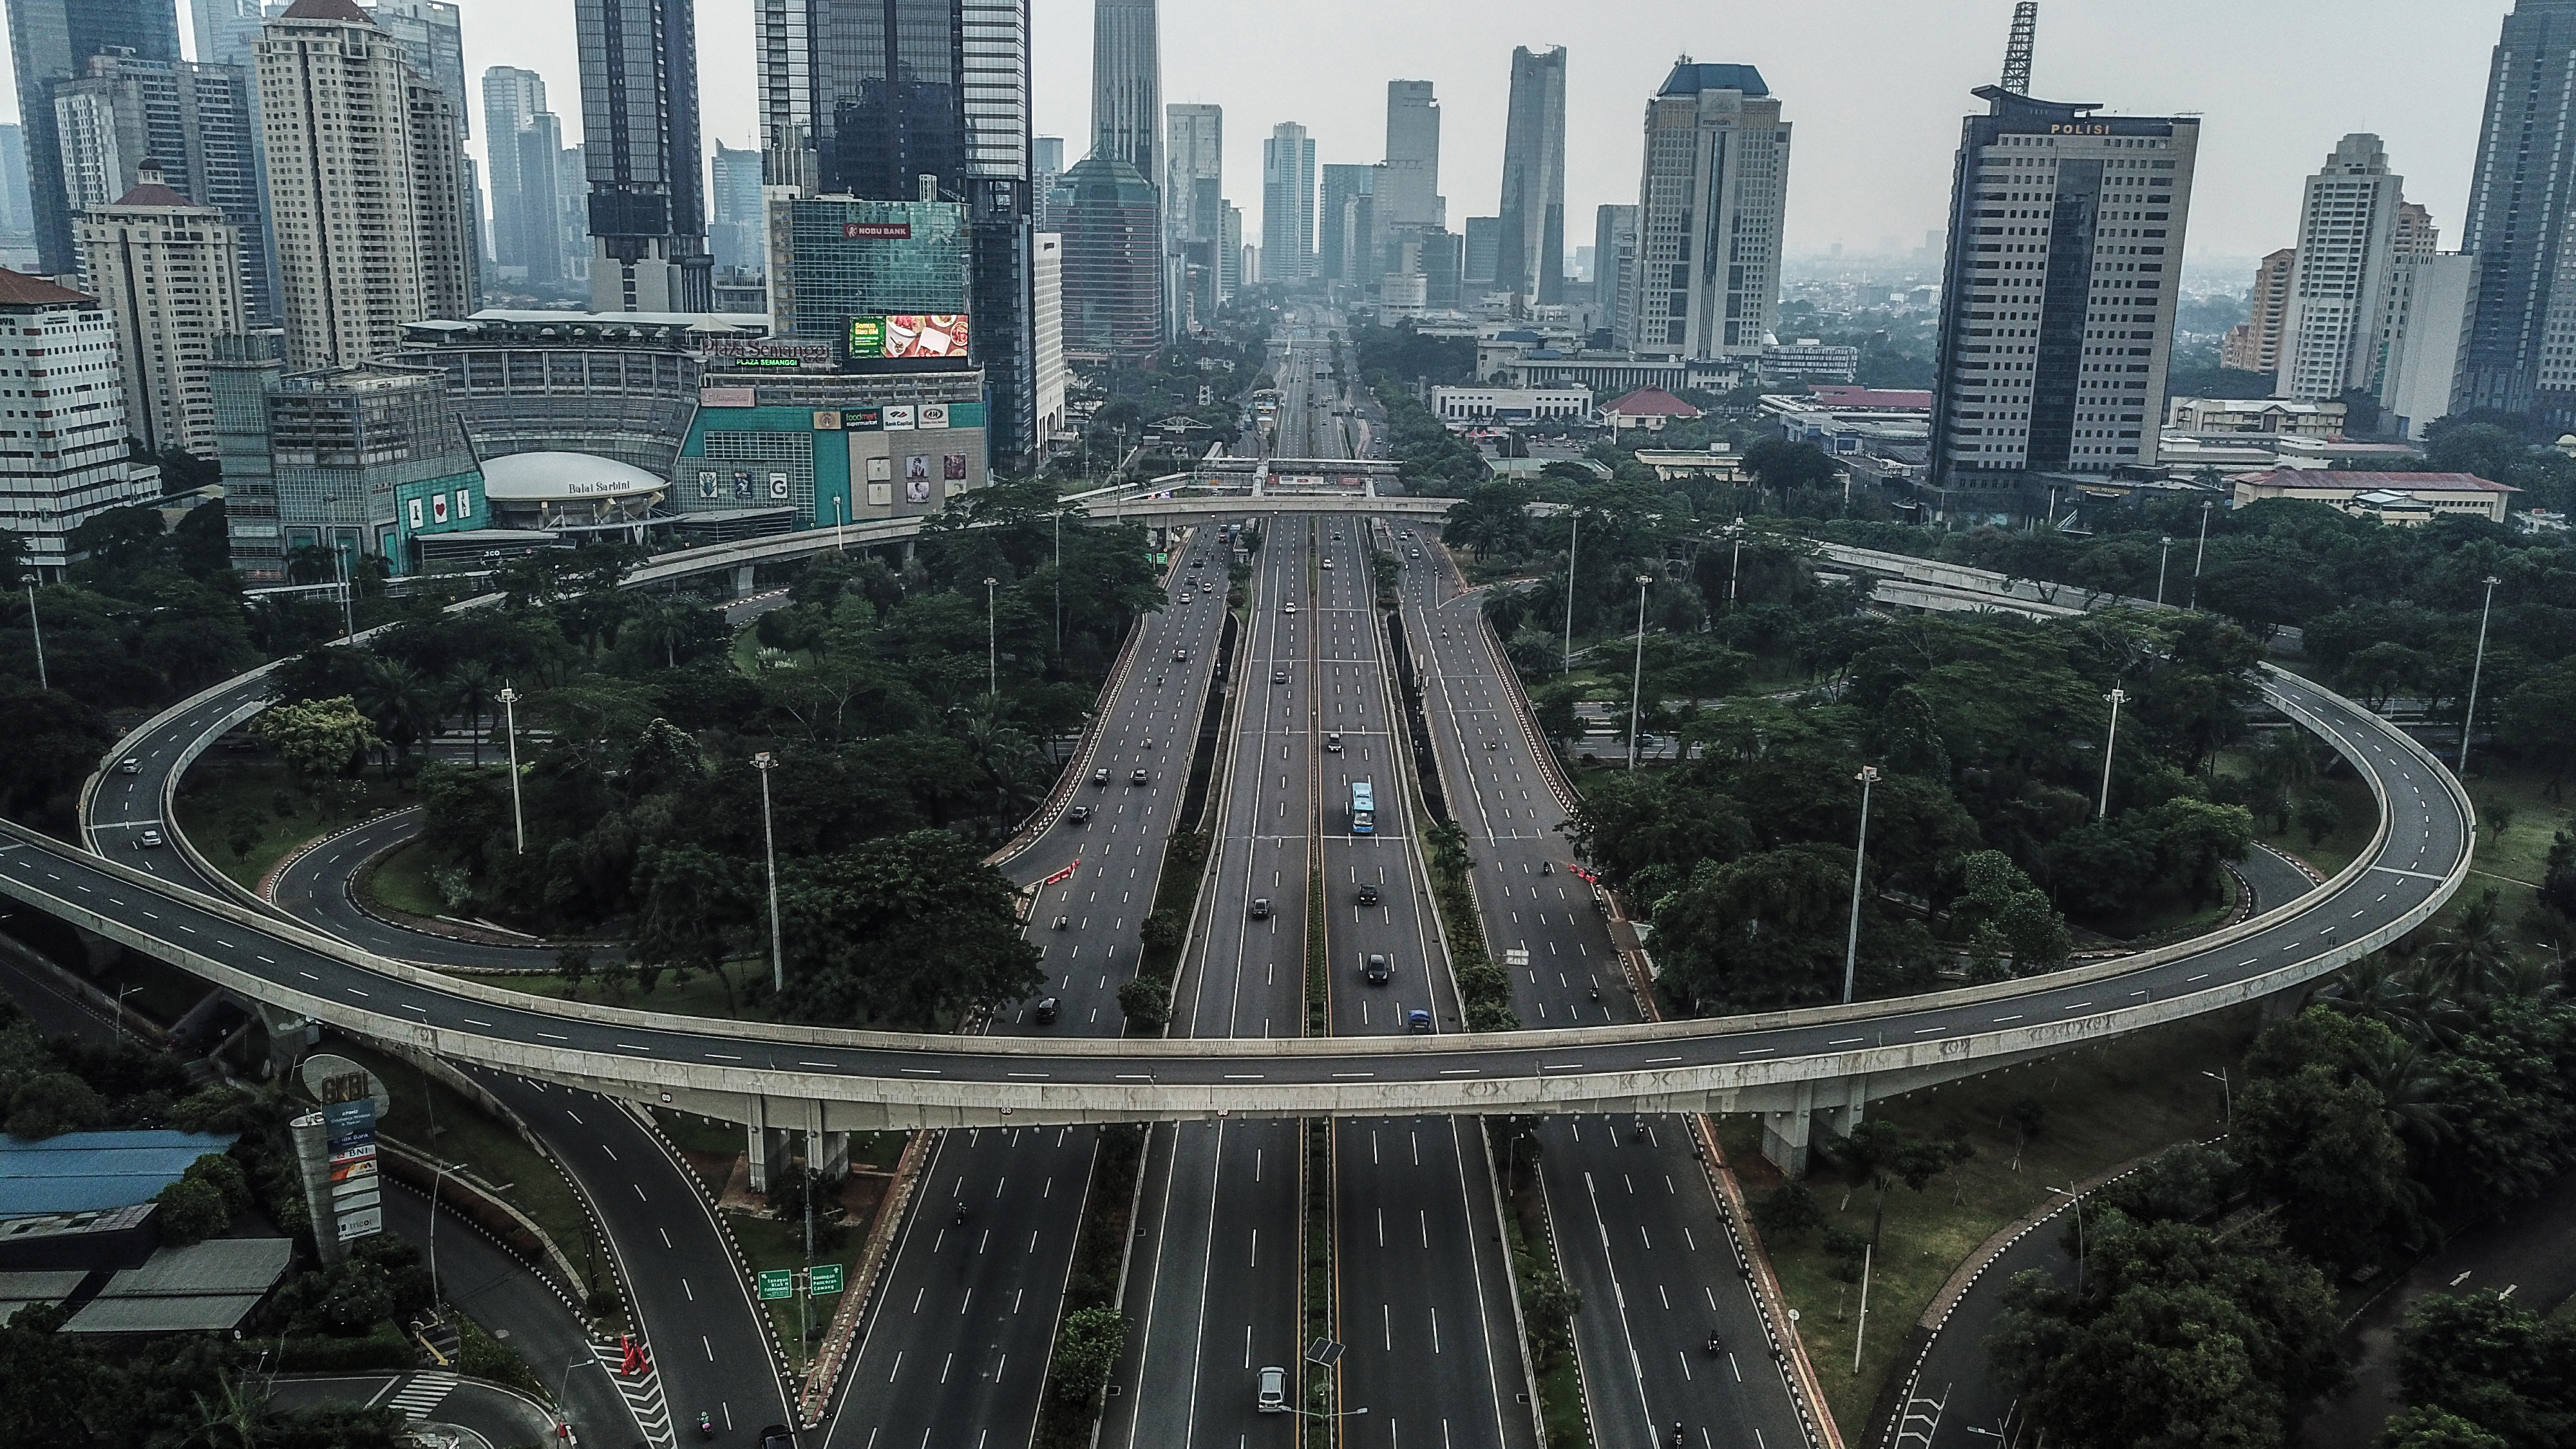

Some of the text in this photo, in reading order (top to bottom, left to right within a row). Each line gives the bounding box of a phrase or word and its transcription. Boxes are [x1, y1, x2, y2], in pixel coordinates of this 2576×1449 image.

[2050, 124, 2109, 135] POLISI
[702, 339, 830, 363] Plaza Semanggi
[846, 412, 877, 421] foodmart
[569, 480, 630, 493] Balai Sarbini
[349, 1148, 368, 1157] BNI
[349, 1218, 373, 1229] tricor
